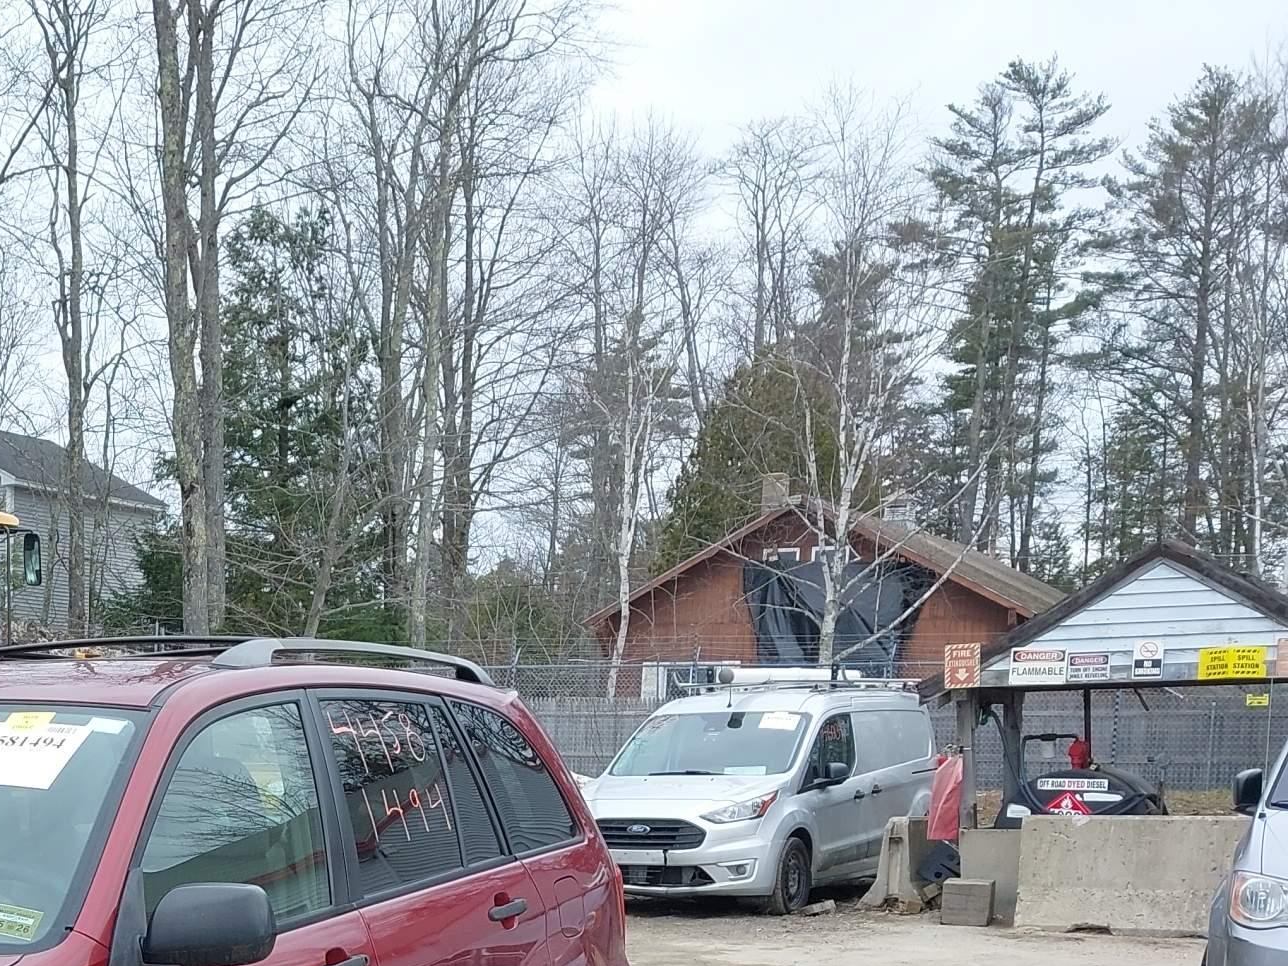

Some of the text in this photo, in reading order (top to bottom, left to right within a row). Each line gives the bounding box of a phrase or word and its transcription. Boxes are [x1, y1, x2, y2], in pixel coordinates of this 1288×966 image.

[952, 649, 972, 658] FIRE
[1019, 651, 1059, 661] DANGER
[1075, 656, 1105, 665] DANGER
[1210, 655, 1226, 663] SPILL
[1232, 662, 1260, 670] STATION
[1012, 666, 1065, 677] FLAMMABLE
[326, 708, 426, 775] 4458
[1039, 780, 1106, 789] OFF ROAD DYED DIESEL
[361, 782, 452, 842] 1494
[15, 924, 31, 934] 26
